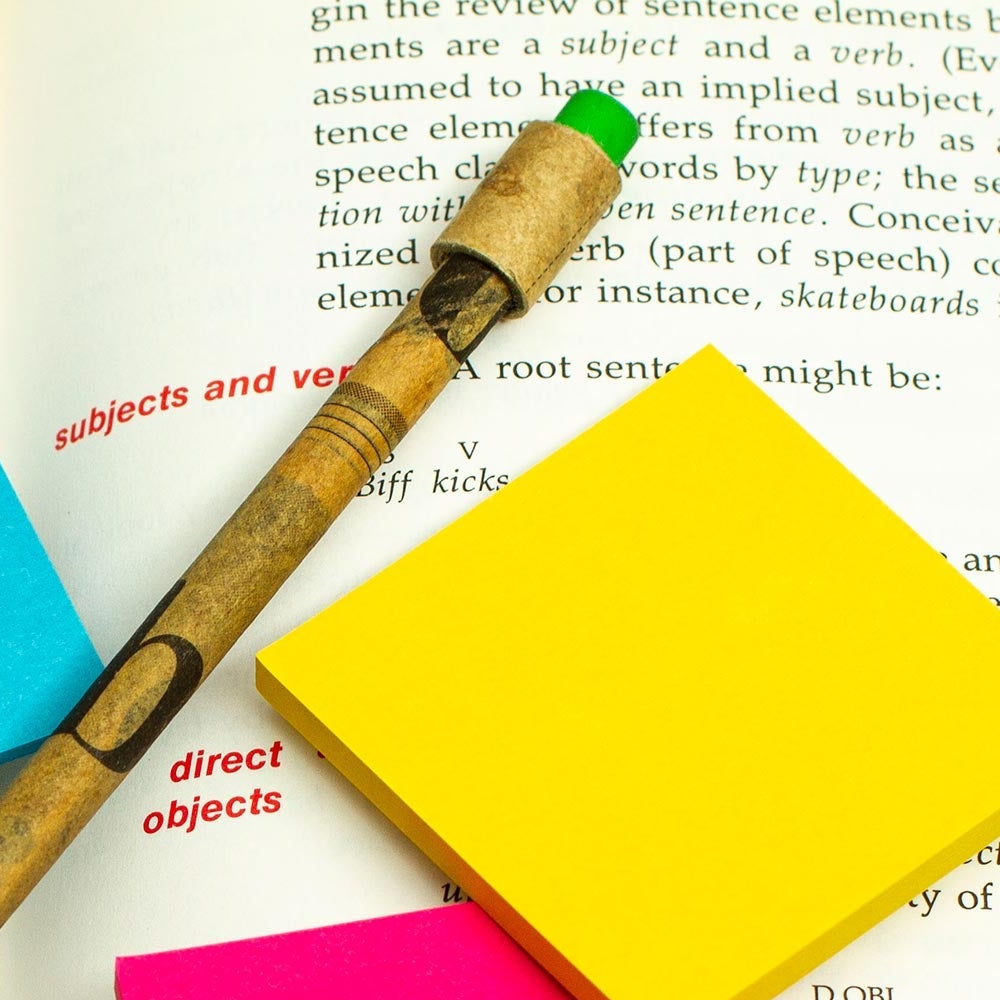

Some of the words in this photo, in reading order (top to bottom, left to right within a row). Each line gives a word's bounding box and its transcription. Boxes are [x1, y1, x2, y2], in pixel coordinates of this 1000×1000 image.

[314, 36, 424, 64] ments
[561, 29, 679, 64] subject
[704, 34, 770, 60] and
[830, 41, 915, 68] verb.
[313, 72, 471, 107] assumed
[701, 76, 839, 109] implied
[856, 82, 994, 117] subject,
[314, 123, 408, 147] tence
[734, 114, 818, 144] from
[842, 122, 915, 149] verb
[315, 155, 438, 194] speech
[733, 155, 779, 191] by
[798, 160, 882, 194] type;
[318, 204, 382, 228] tion
[671, 199, 827, 226] sentence.
[316, 238, 420, 270] nized
[649, 235, 735, 271] (part
[814, 245, 950, 279] speech)
[597, 278, 762, 311] instance,
[780, 281, 979, 317] skateboards
[495, 355, 572, 380] root
[762, 359, 873, 394] might
[886, 362, 941, 391] be:
[54, 385, 189, 452] subjects
[203, 365, 277, 402] and
[457, 440, 479, 460] V
[432, 467, 509, 494] kicks
[169, 740, 284, 784] direct
[142, 787, 282, 835] objects
